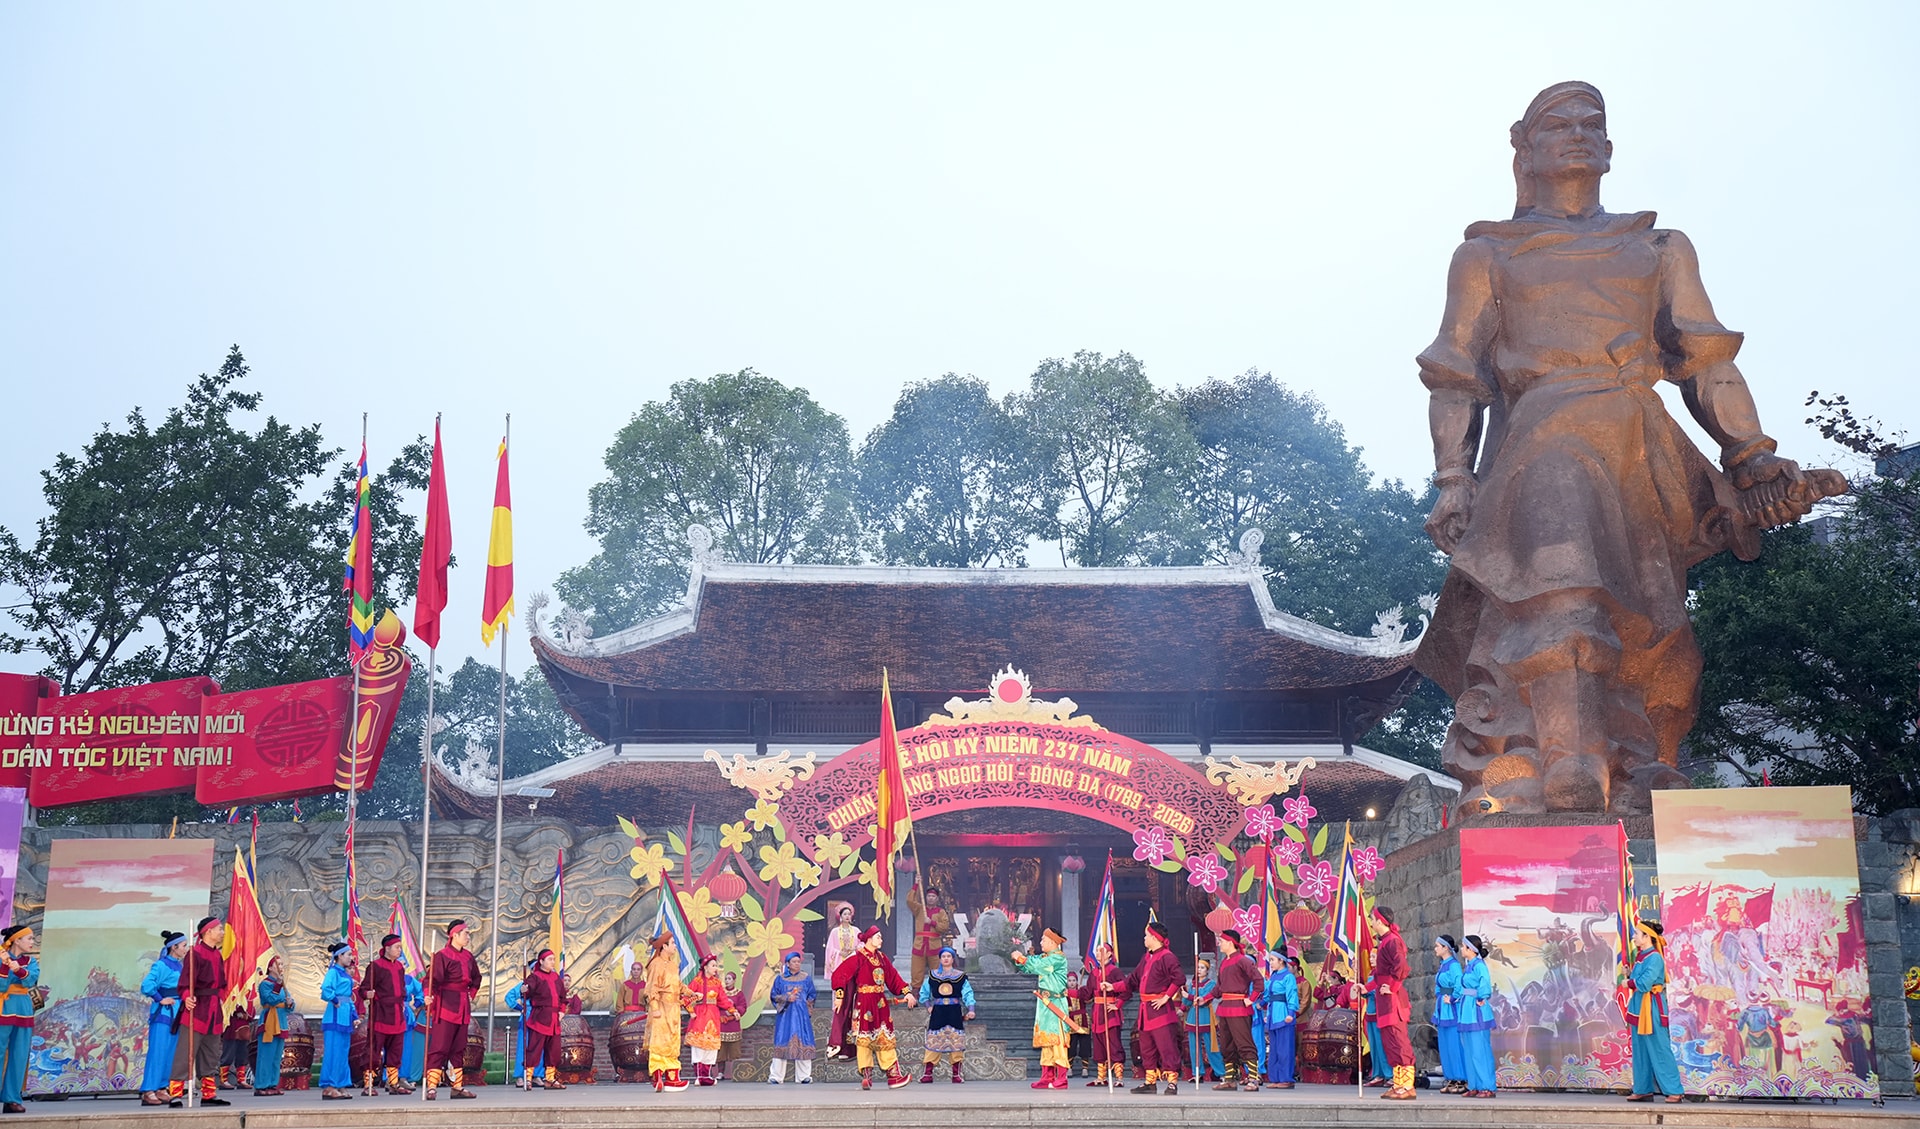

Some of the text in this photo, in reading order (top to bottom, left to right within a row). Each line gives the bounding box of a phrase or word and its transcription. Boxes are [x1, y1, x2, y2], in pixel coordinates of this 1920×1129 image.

[0, 708, 245, 735] ỪNG KỶ NGUYÊN MỚI
[2, 743, 53, 768] DÂN
[58, 742, 107, 772] TỘC
[112, 742, 168, 772] VIỆT
[915, 739, 950, 763] HỘI
[953, 732, 979, 756] KỶ
[985, 733, 1038, 757] NIỆM
[1044, 740, 1080, 761] 237
[1083, 747, 1132, 777] NĂM
[827, 795, 877, 830] CHIẾN
[937, 765, 981, 788] NGỌC
[986, 759, 1014, 782] HỒI
[1030, 762, 1074, 788] ĐỐNG
[1078, 773, 1101, 795] ĐA
[1104, 783, 1143, 810] (1789
[1153, 803, 1194, 834] 2026)
